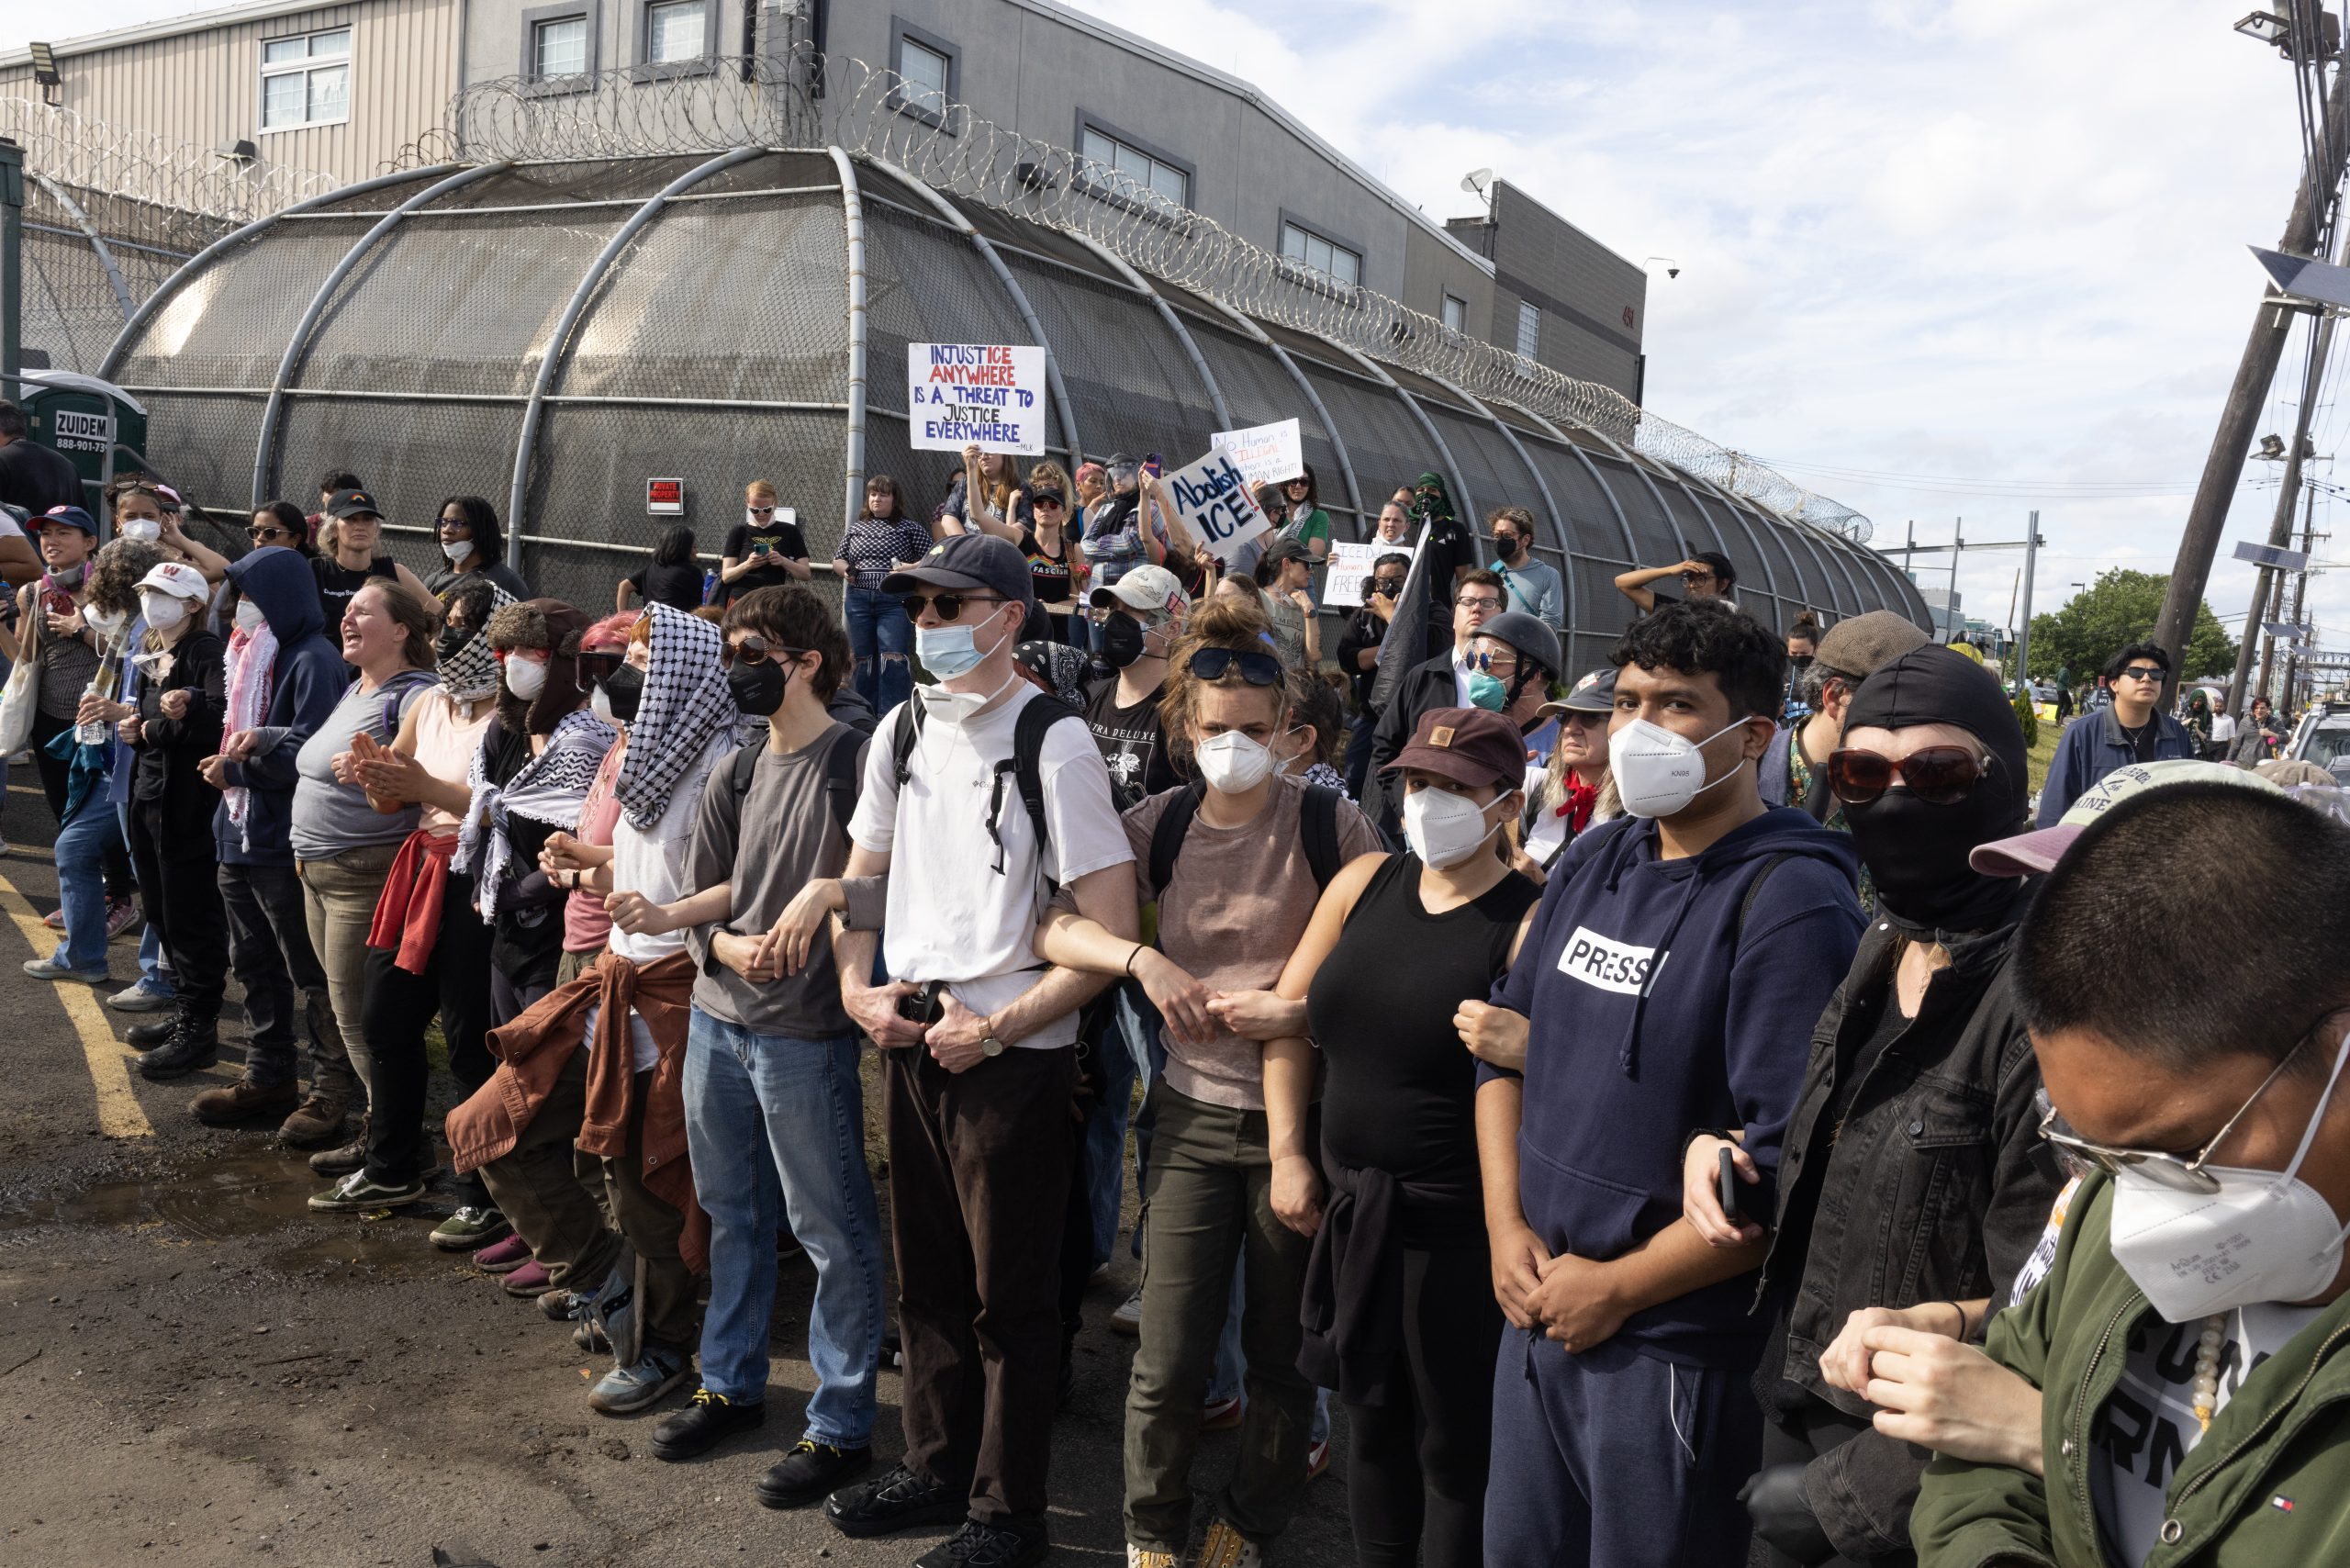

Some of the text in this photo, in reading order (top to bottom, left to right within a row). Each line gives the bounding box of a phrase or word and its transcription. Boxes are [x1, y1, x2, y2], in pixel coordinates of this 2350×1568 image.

[930, 344, 1013, 365] INJUSTICE
[929, 364, 1016, 386] ANYWHERE
[914, 386, 1035, 408] IS A THREAT TO
[943, 403, 1001, 423] JUSTICE
[57, 413, 108, 438] ZUIDEM
[925, 420, 1021, 442] EVERYWHERE
[56, 438, 108, 453] 888-901-73
[1242, 431, 1275, 448] Human
[1239, 463, 1260, 473] ation
[650, 490, 679, 498] PROPERTY
[653, 481, 677, 490] PRIVATE
[1171, 456, 1244, 515] Abolish
[1196, 484, 1260, 543] ICE!
[1339, 545, 1363, 558] ICE
[163, 565, 181, 577] W
[1087, 720, 1156, 741] TRA DELUXE
[1568, 938, 1652, 986] PRESS
